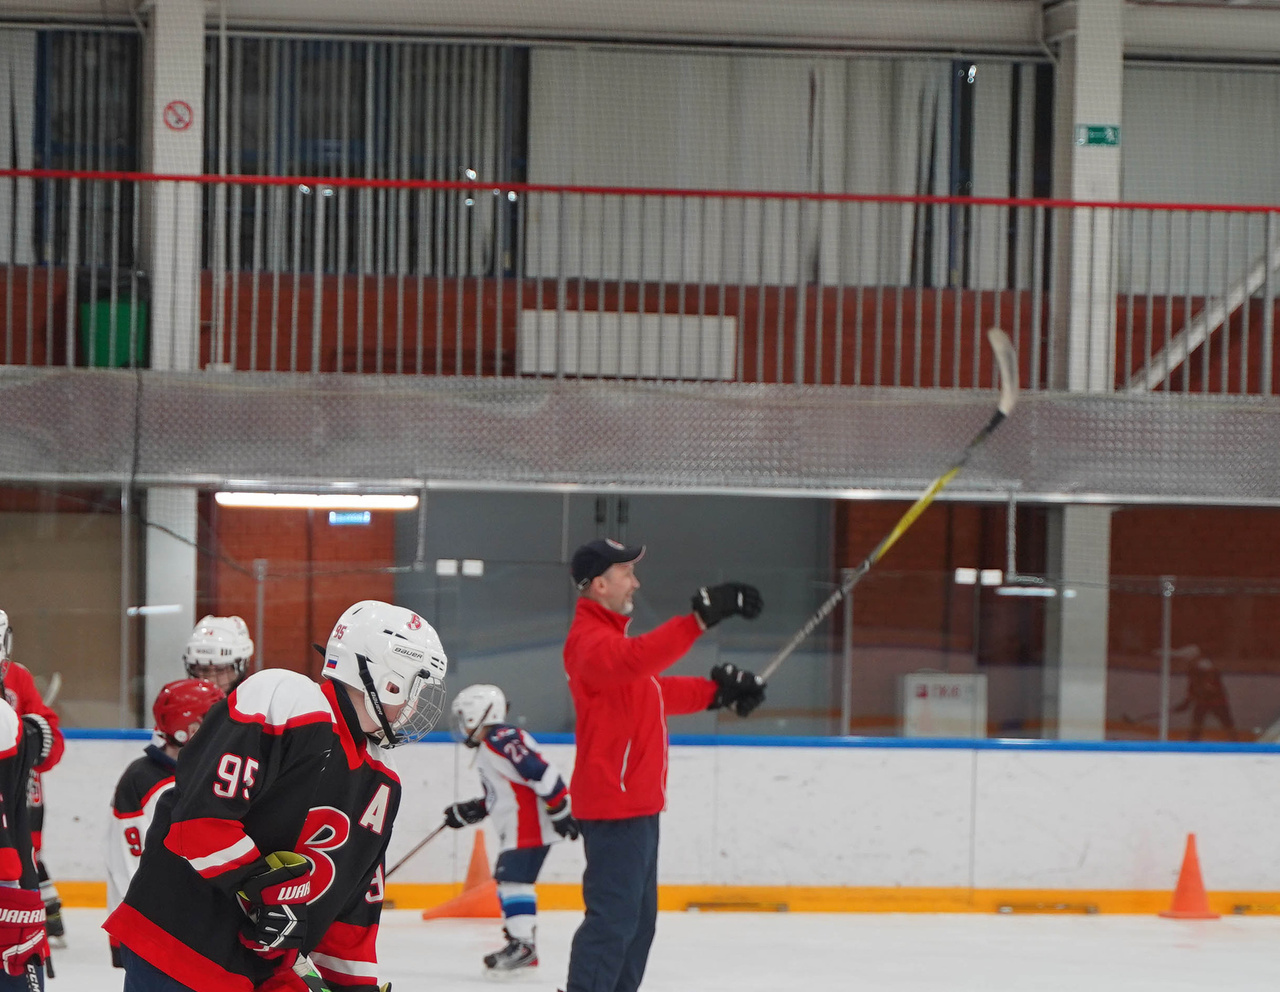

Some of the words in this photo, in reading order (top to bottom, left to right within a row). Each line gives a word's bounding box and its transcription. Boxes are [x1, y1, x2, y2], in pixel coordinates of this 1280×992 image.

[334, 624, 347, 640] 95
[394, 647, 423, 659] BAUER
[370, 691, 383, 716] BAUER
[213, 752, 259, 800] 95
[358, 783, 391, 836] A
[26, 963, 40, 992] CCM
